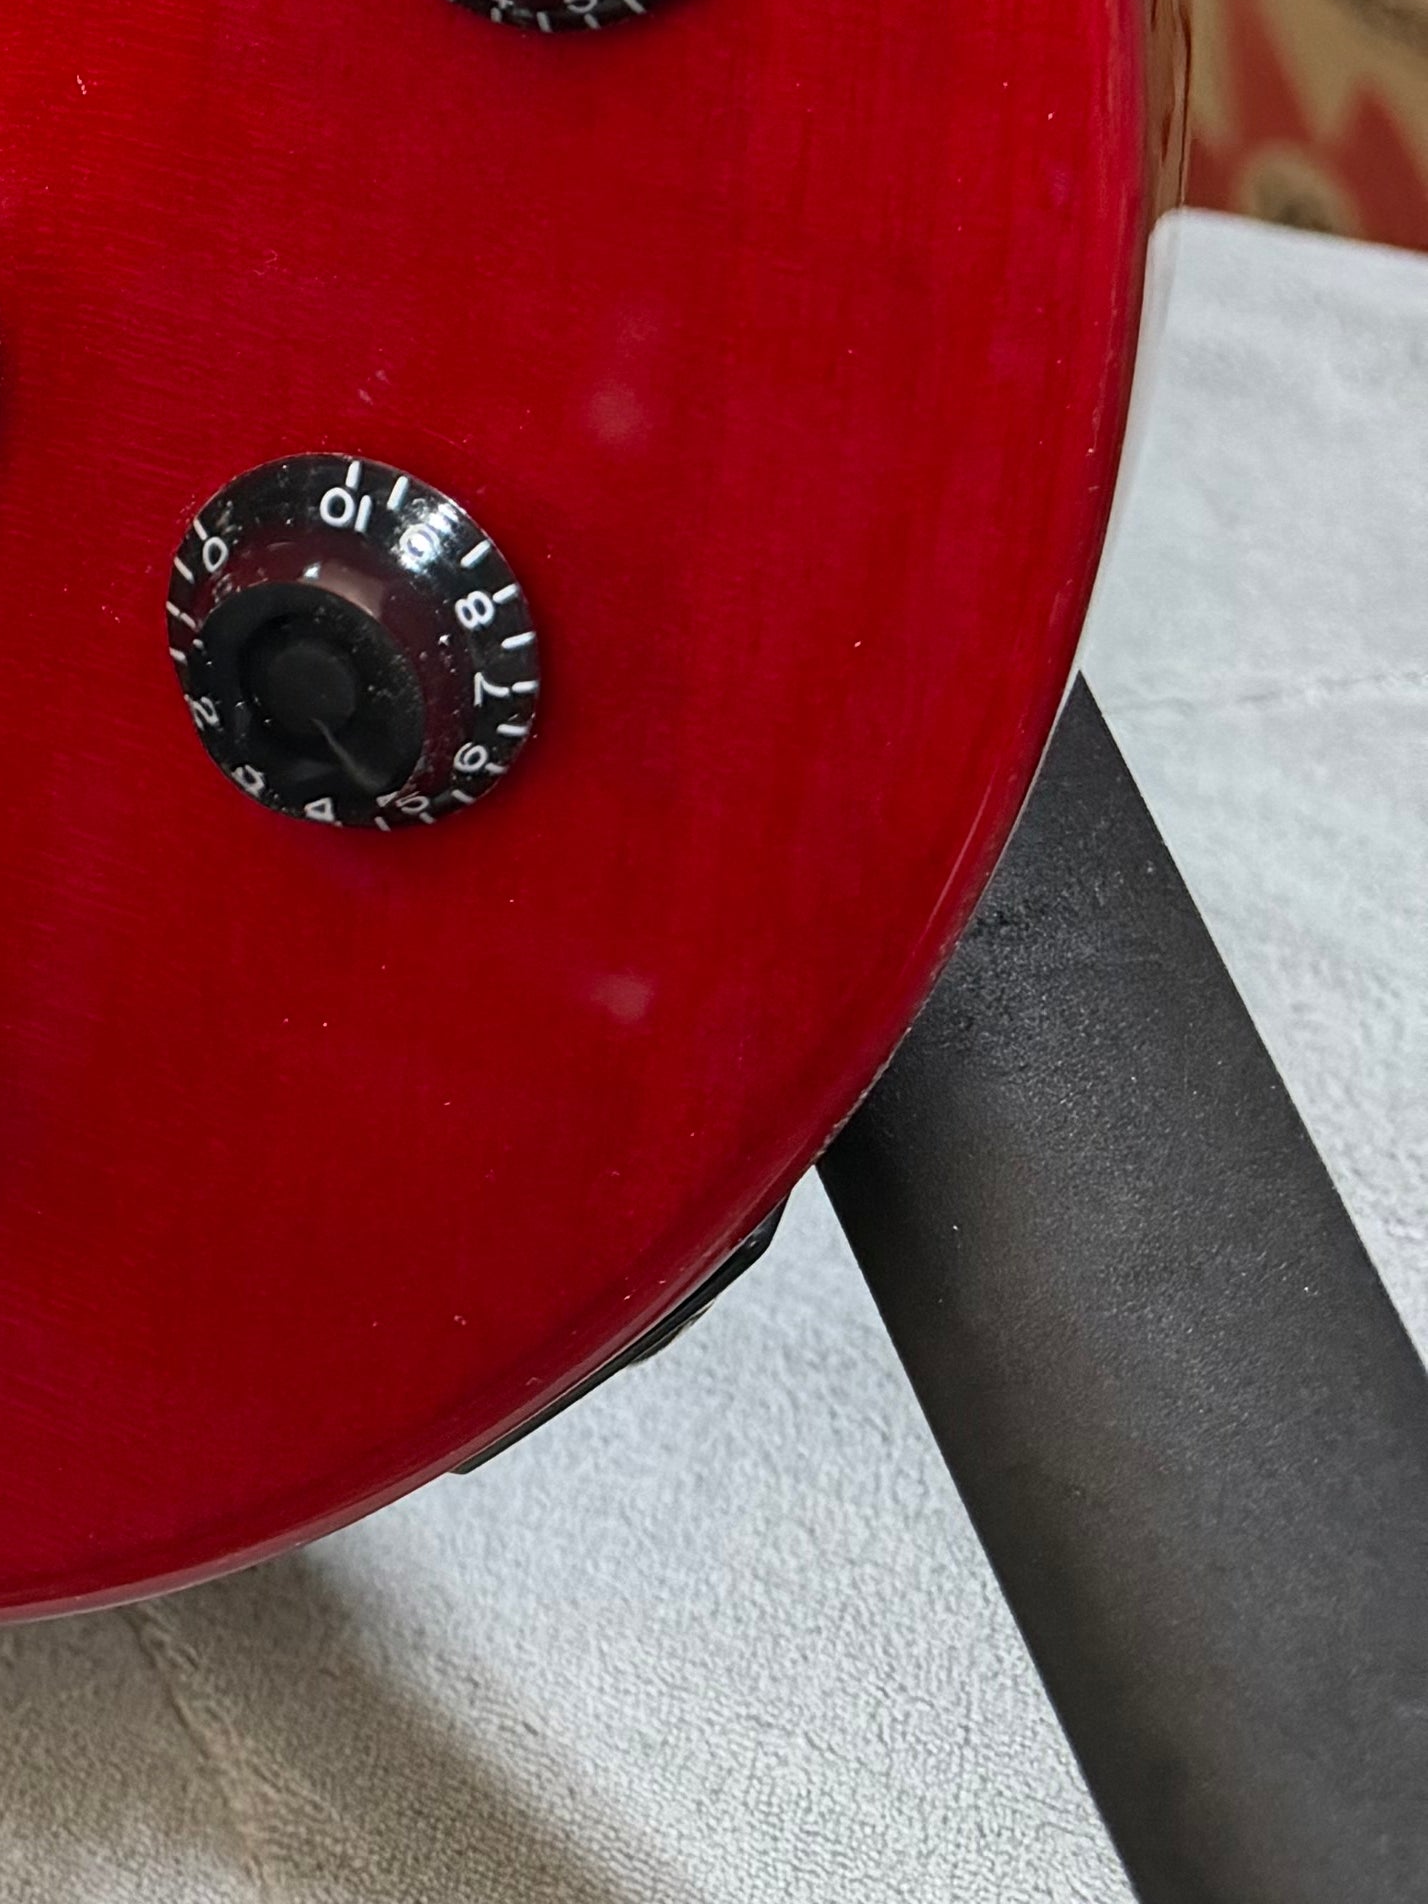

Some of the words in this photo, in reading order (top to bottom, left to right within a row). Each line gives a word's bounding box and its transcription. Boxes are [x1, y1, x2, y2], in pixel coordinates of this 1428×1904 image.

[319, 487, 373, 533] 10
[202, 536, 229, 573] 0
[454, 591, 495, 629] 8
[473, 671, 509, 707] 7
